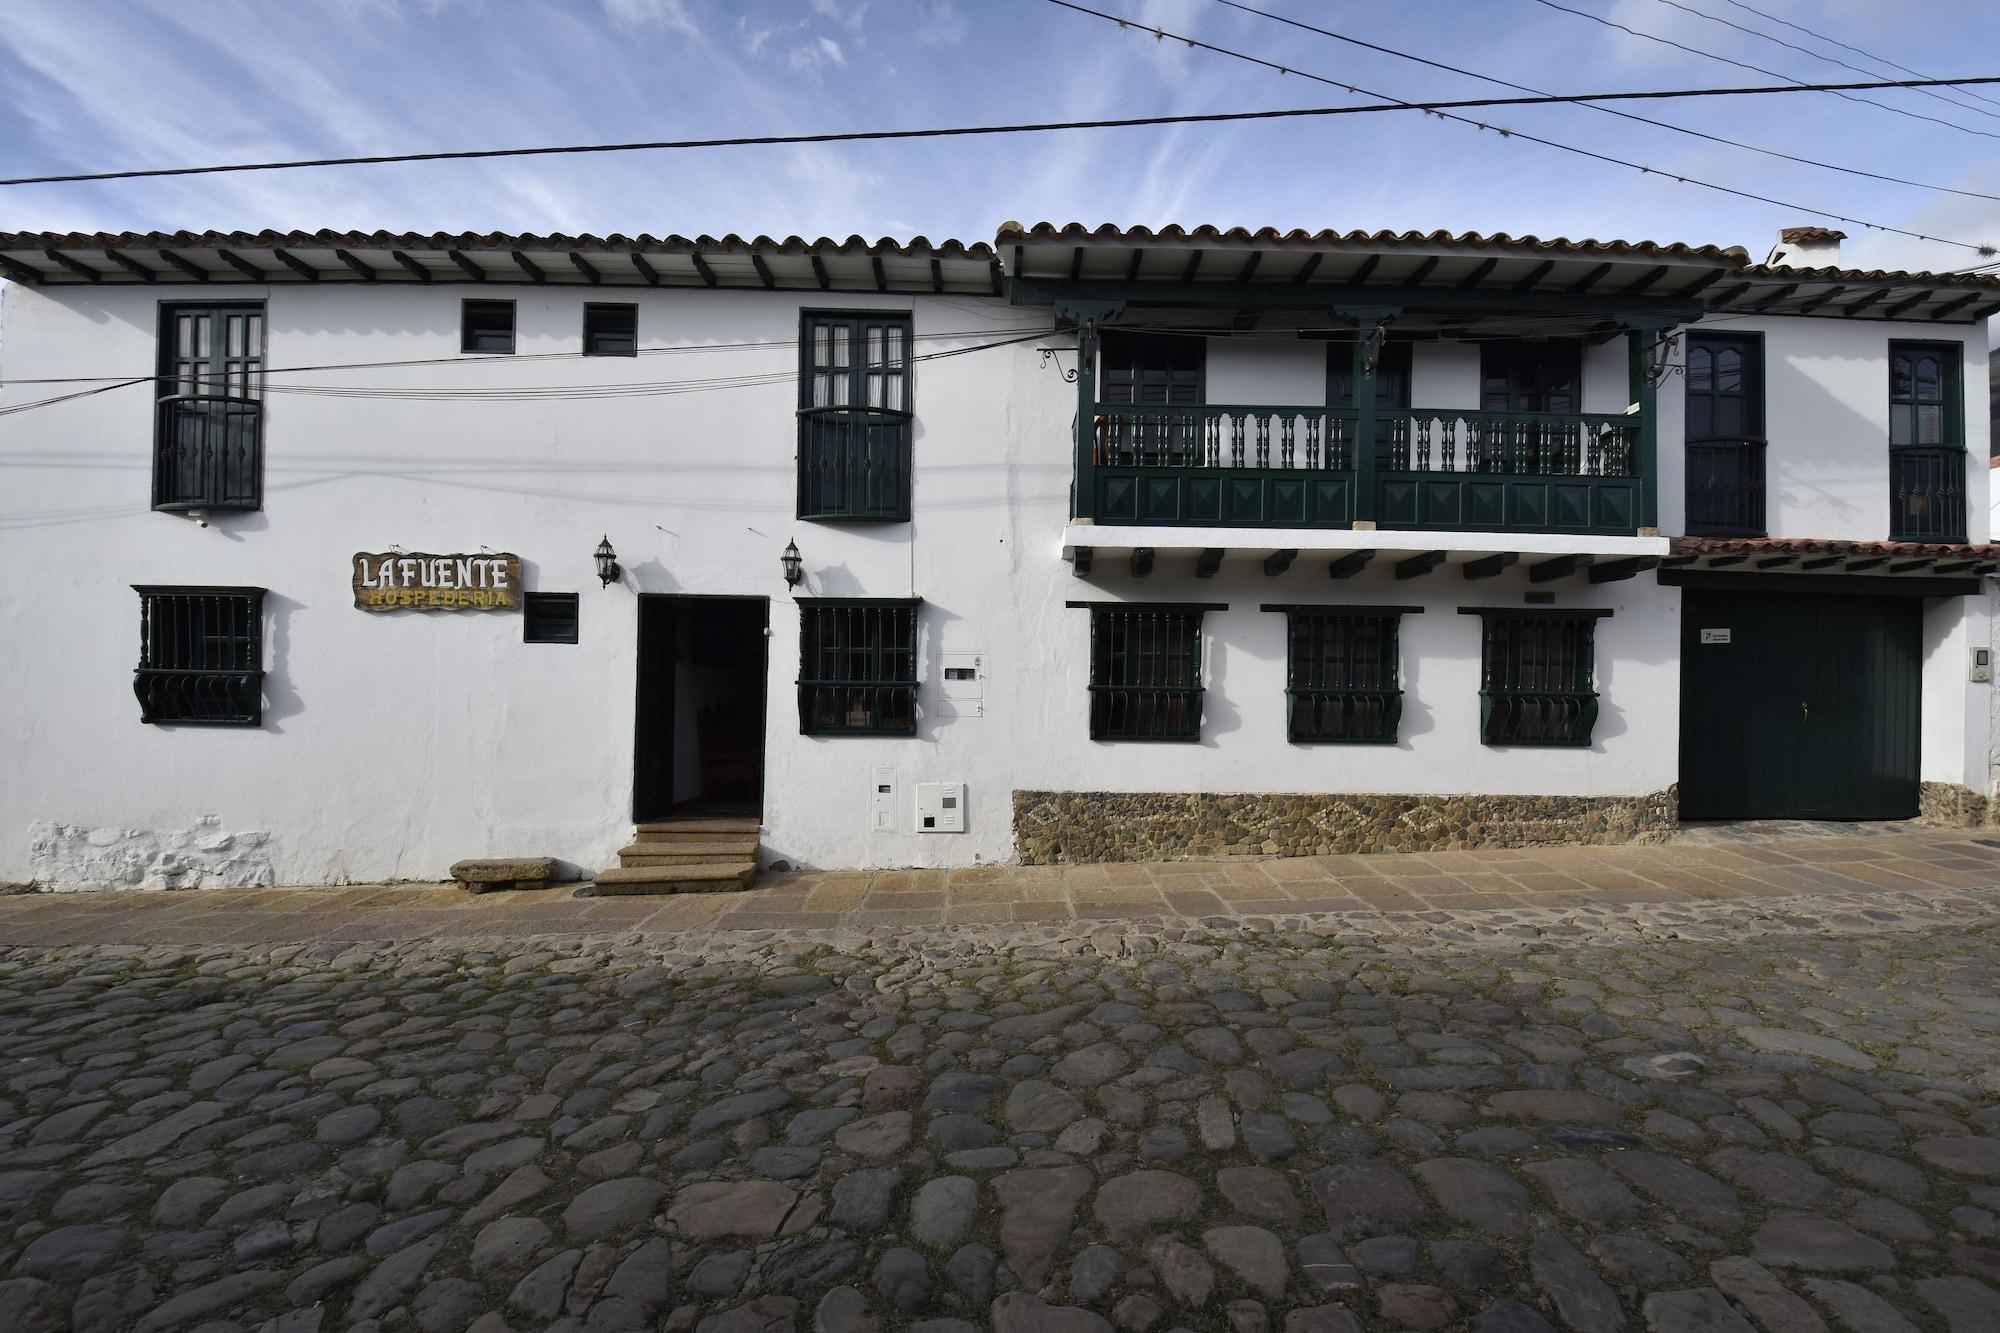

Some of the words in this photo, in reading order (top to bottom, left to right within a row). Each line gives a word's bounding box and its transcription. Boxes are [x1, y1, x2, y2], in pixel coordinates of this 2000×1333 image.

[359, 558, 395, 590] LA
[397, 557, 508, 590] FUENTE
[367, 589, 508, 606] HOSPEDERIA
